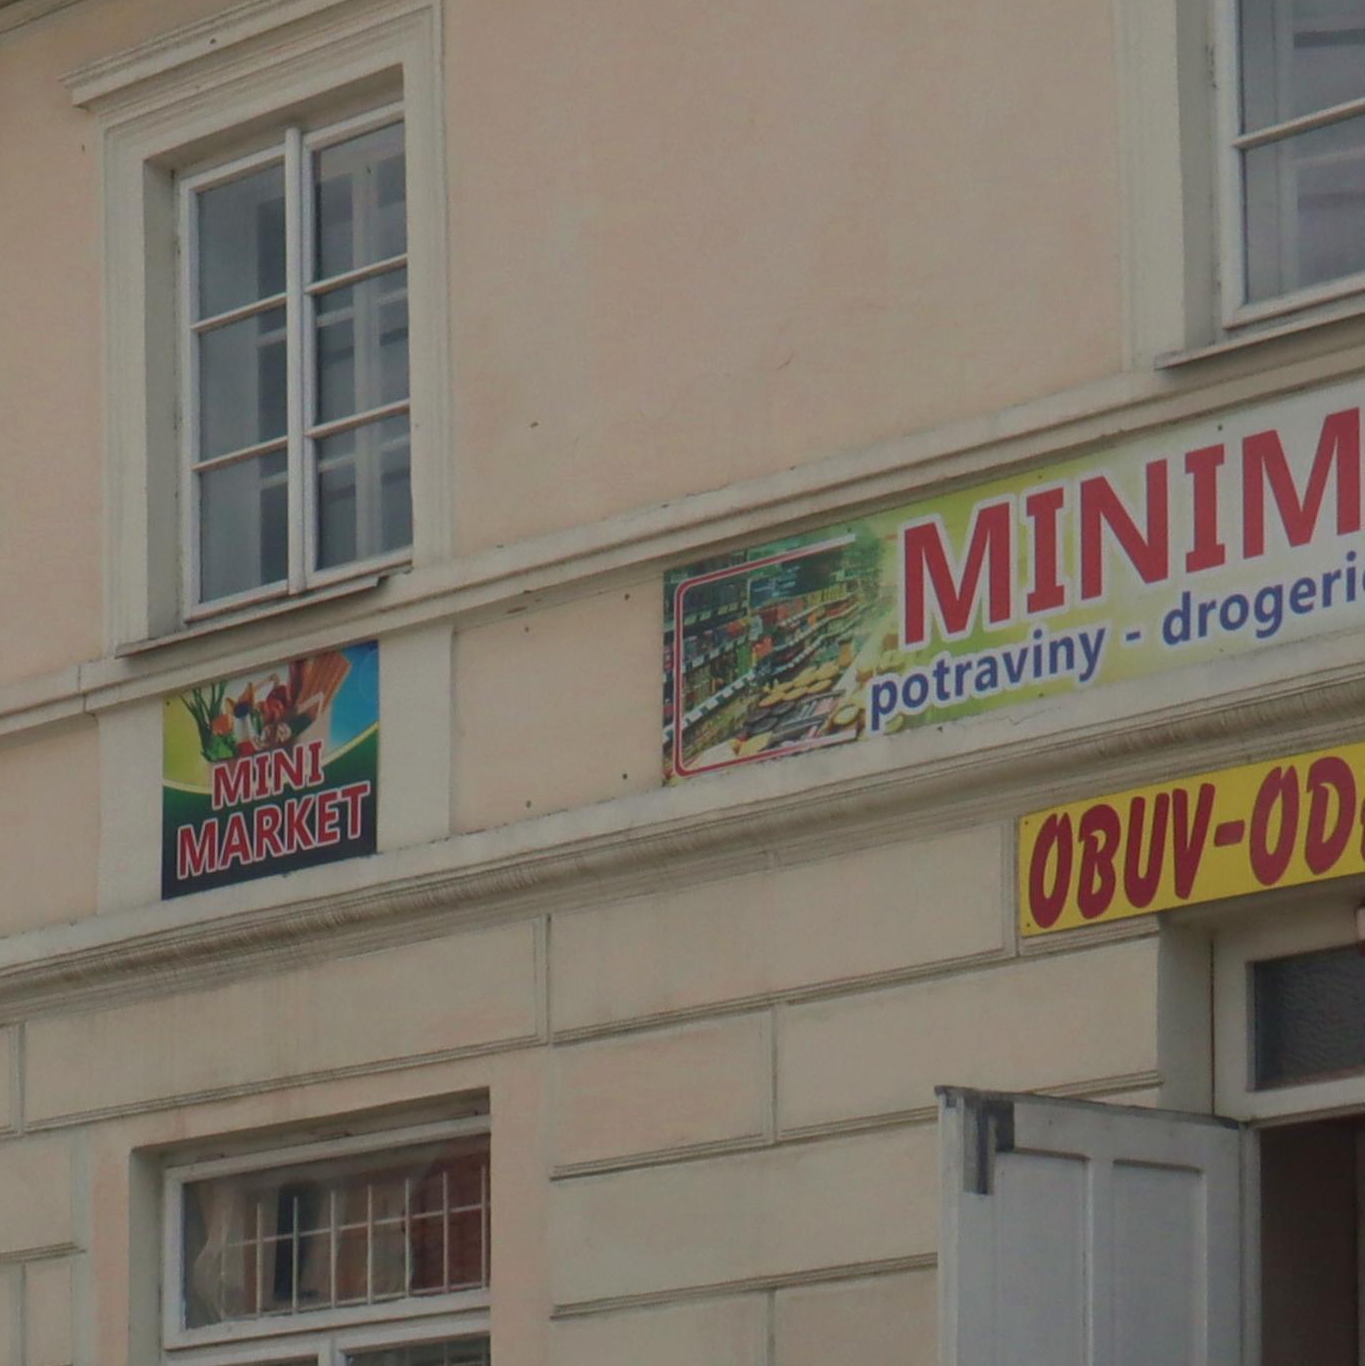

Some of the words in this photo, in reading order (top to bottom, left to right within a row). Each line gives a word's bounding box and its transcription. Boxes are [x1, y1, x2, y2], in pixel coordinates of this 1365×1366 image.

[903, 406, 1362, 645] MINIM
[870, 628, 1107, 732] potraviny
[1162, 550, 1365, 646] drogeri
[178, 783, 369, 878] MARKET
[213, 741, 324, 808] MINI
[1028, 755, 1365, 929] OBUV-OD
